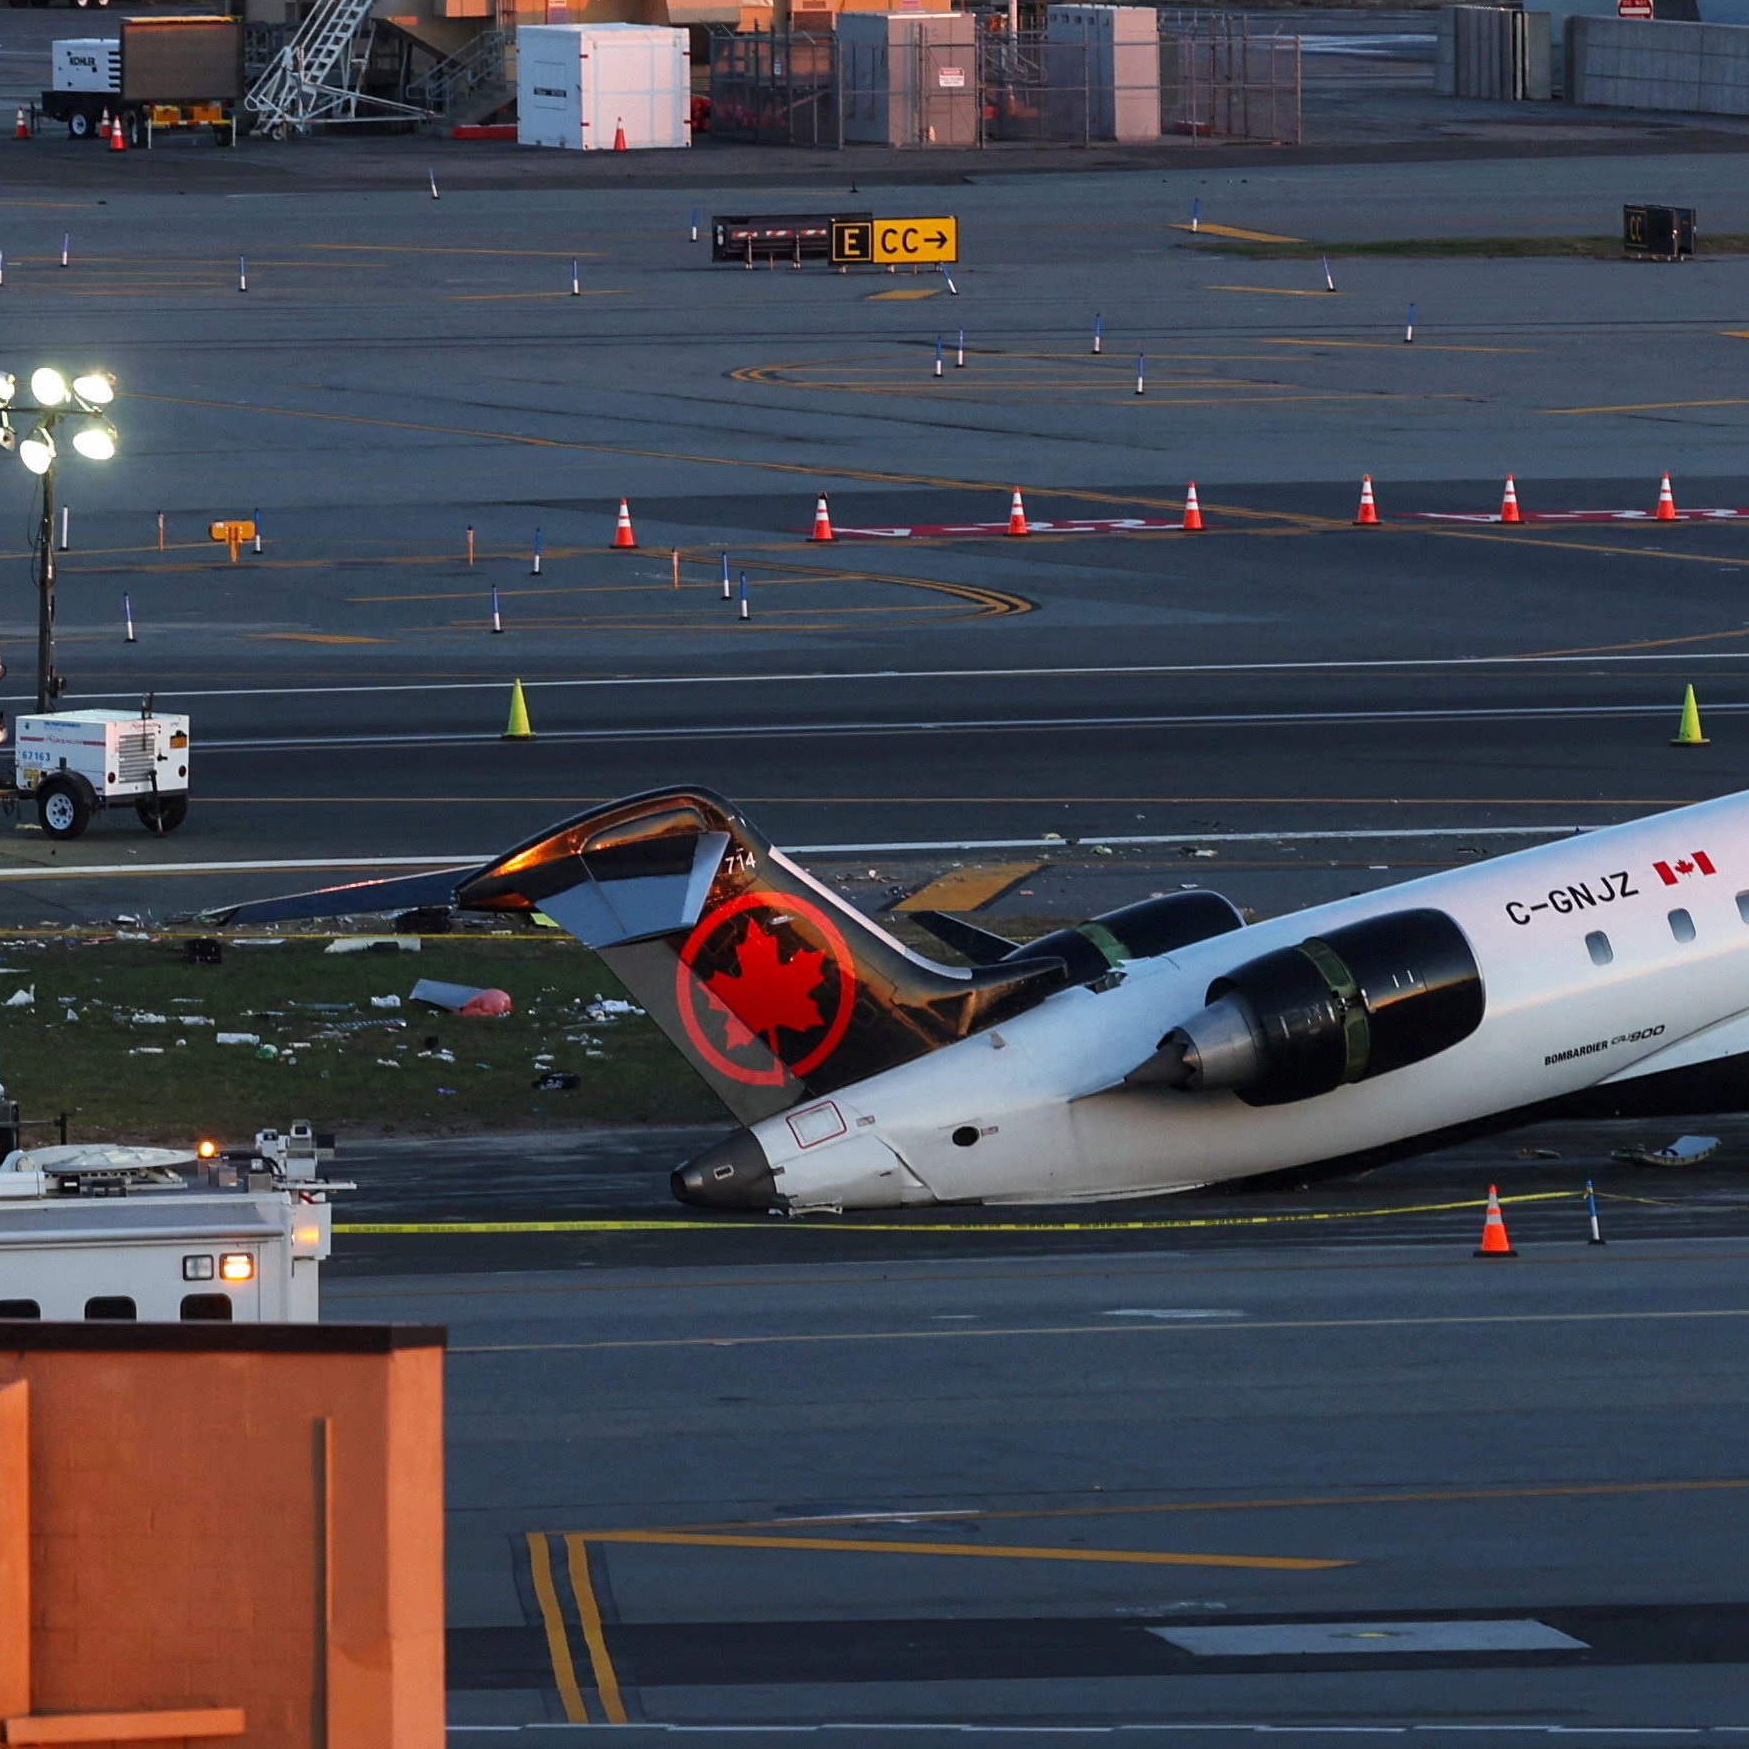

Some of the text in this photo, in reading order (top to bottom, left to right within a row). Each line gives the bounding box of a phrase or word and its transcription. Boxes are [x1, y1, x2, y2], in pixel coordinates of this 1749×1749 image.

[69, 56, 96, 67] KOHLER
[844, 228, 861, 255] E
[881, 228, 919, 254] CC
[22, 751, 51, 762] 67163
[725, 851, 756, 875] 714
[1506, 871, 1640, 928] C-GNJZ
[1544, 1040, 1609, 1066] BOMBARDIER
